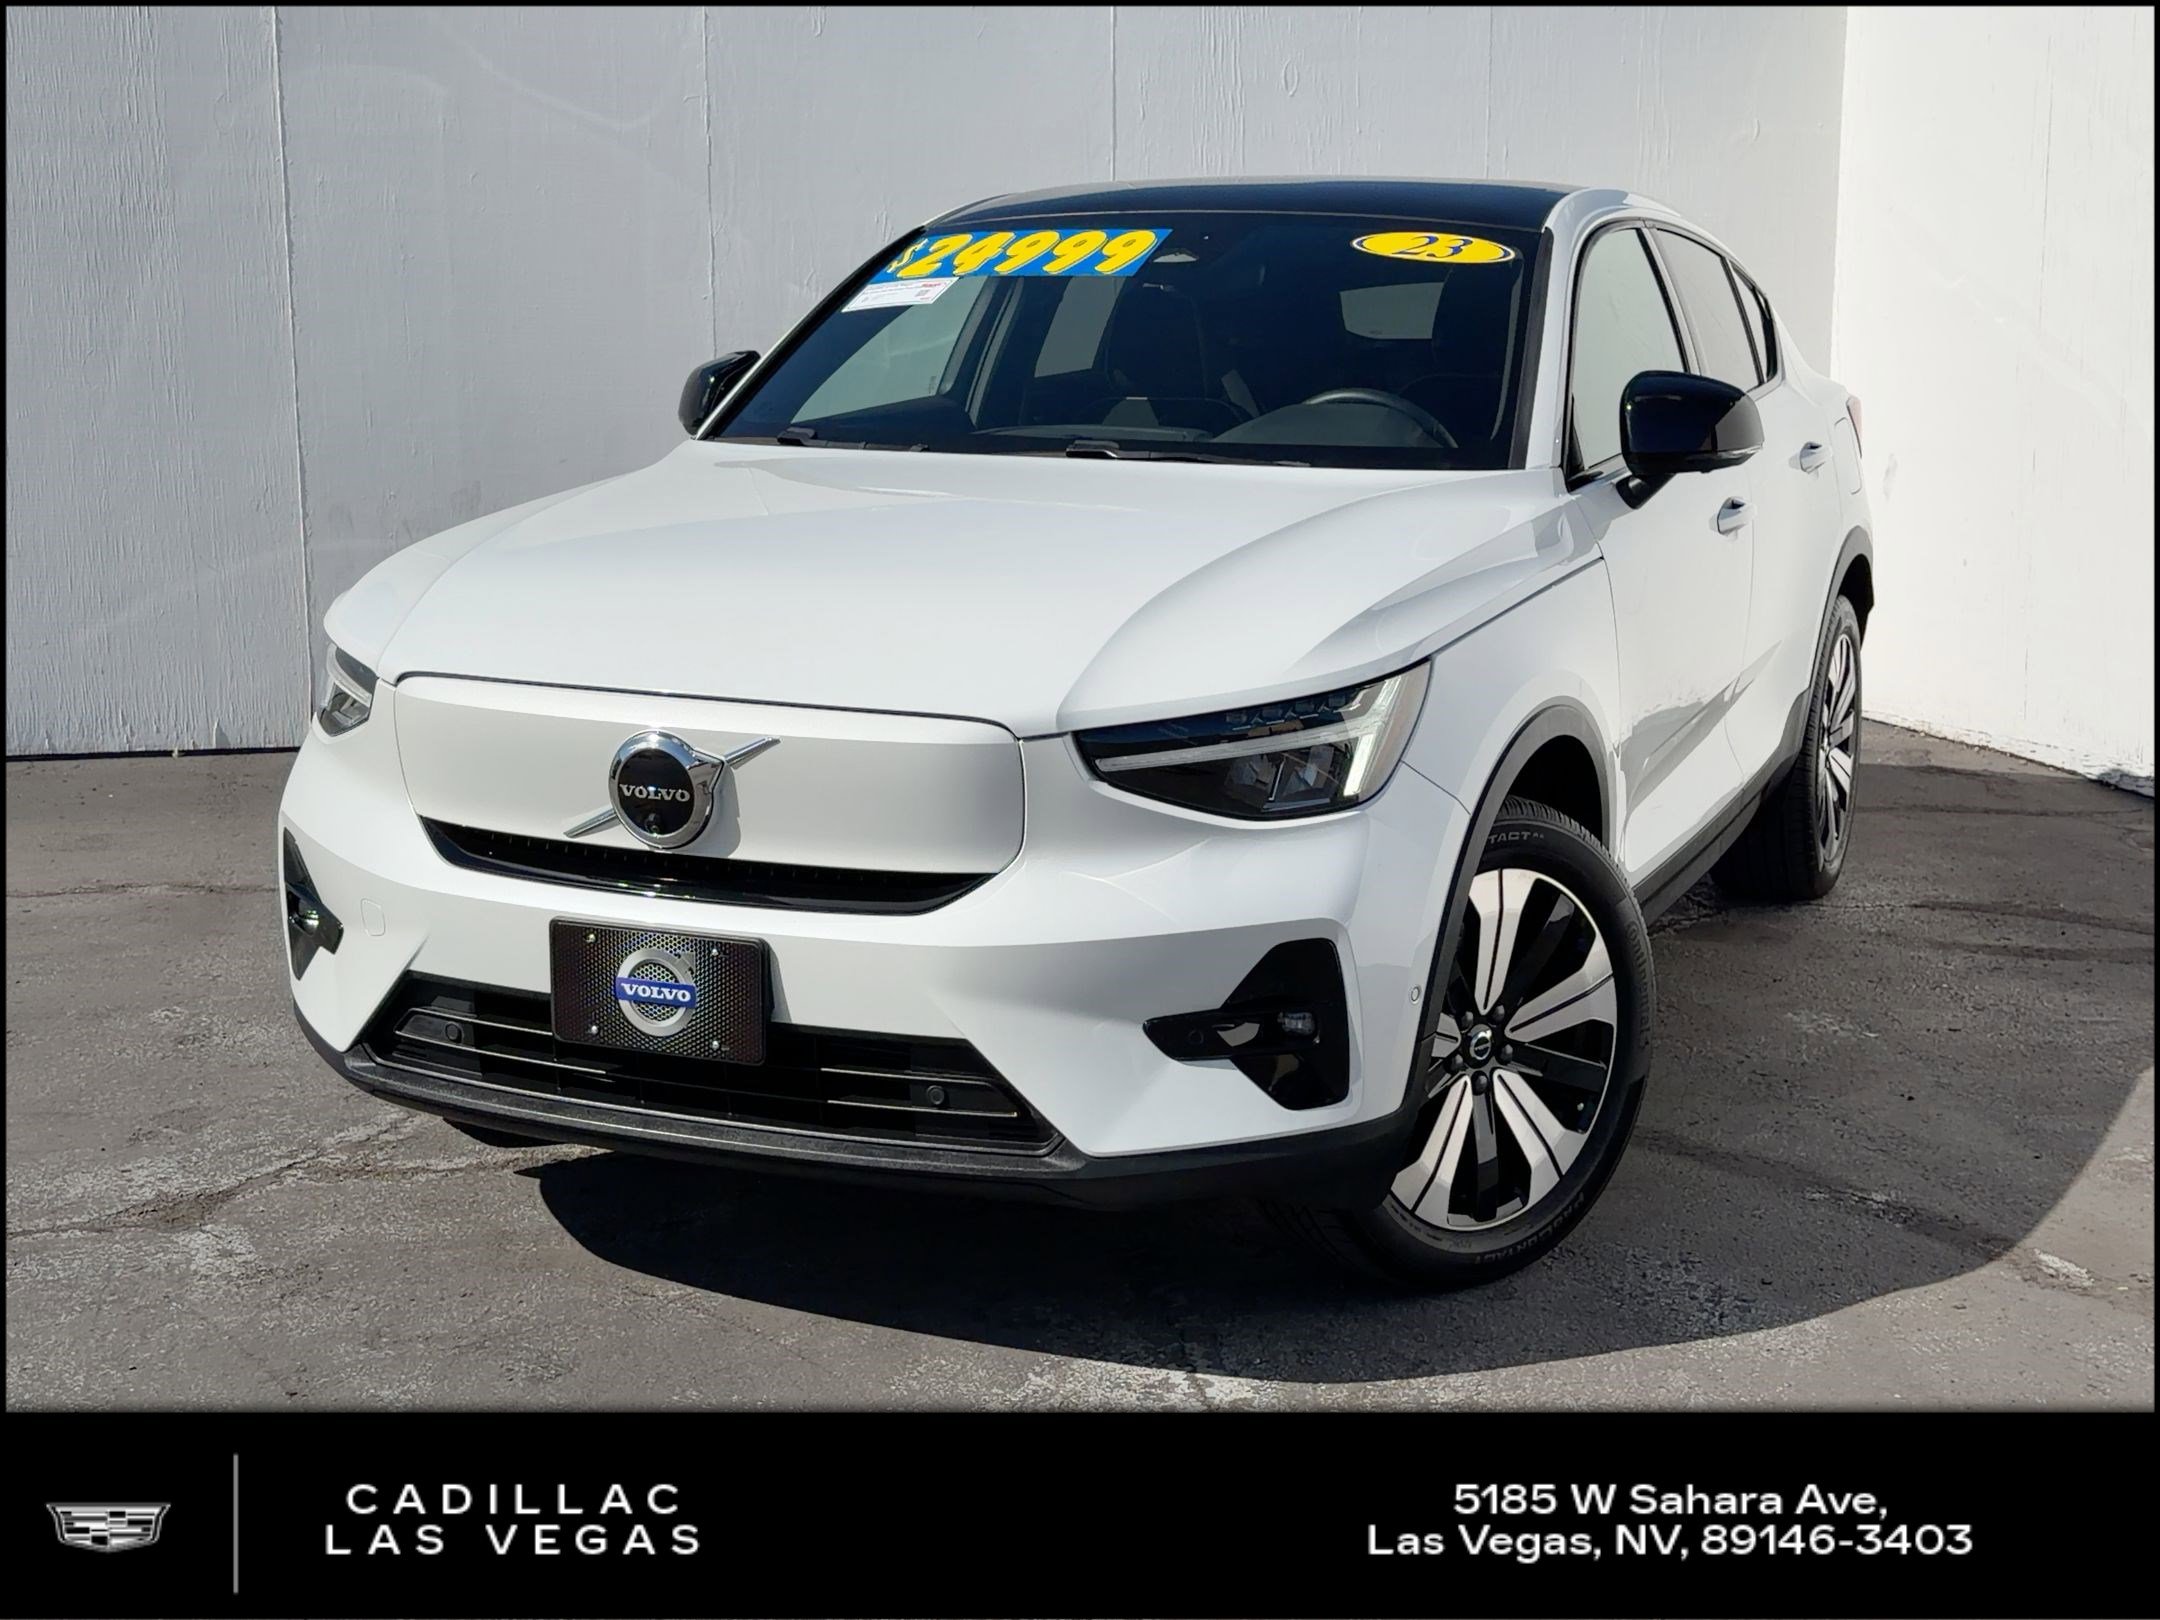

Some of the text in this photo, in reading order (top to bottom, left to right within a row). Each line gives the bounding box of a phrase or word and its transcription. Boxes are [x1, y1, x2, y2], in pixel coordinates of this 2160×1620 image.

[887, 229, 1159, 279] $24999
[1392, 235, 1474, 259] 23
[618, 783, 691, 803] VOLVO
[620, 982, 692, 1003] VOLVO
